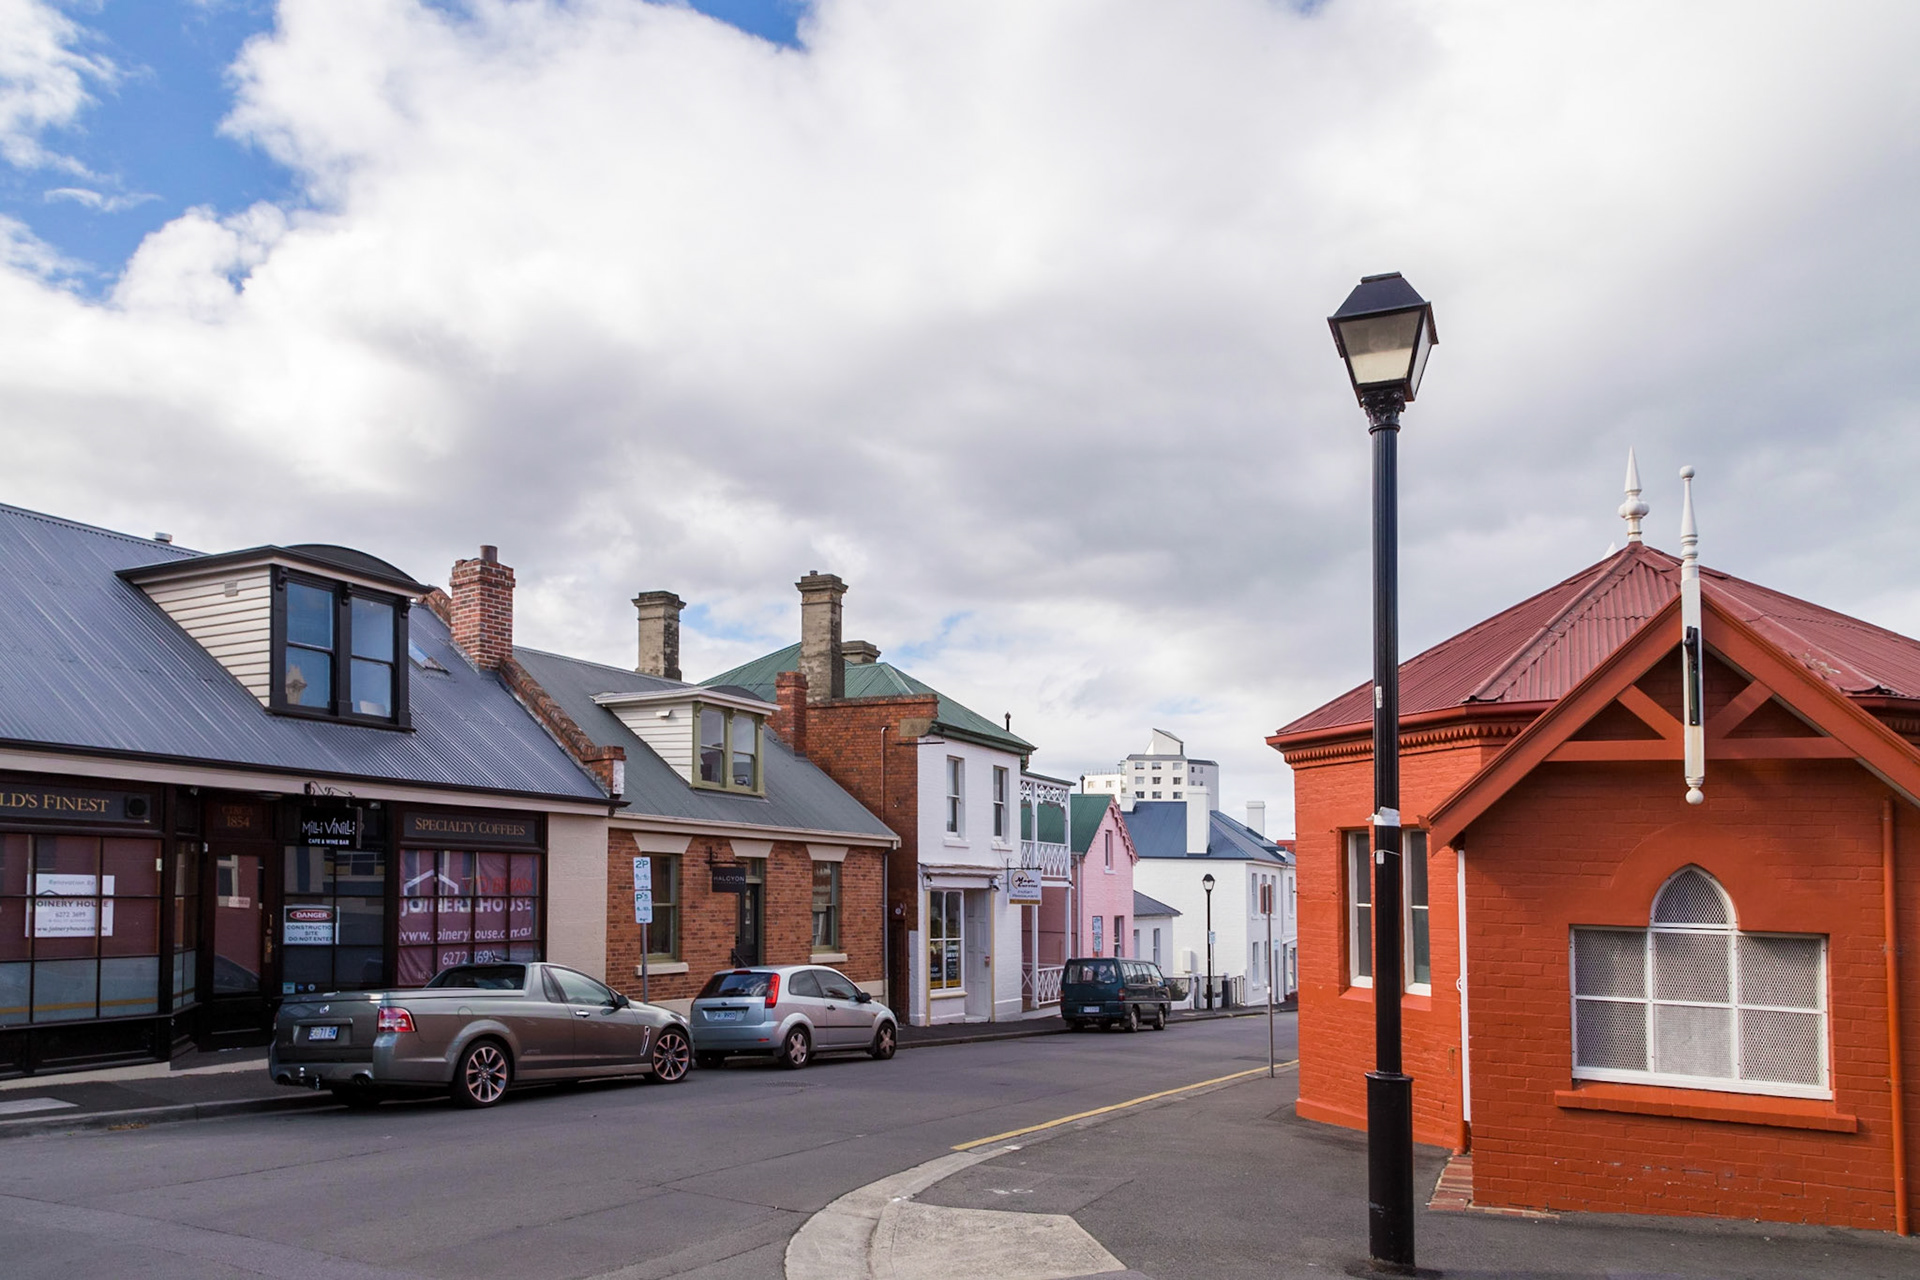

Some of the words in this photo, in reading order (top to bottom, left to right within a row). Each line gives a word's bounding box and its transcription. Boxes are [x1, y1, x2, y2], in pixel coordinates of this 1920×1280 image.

[43, 794, 110, 812] FINEST
[227, 815, 250, 828] 1854
[415, 818, 477, 833] SPECIALTY
[479, 822, 526, 836] COFFEES
[635, 860, 649, 869] 2P
[36, 900, 73, 908] OINERY
[76, 900, 109, 908] HOUE
[479, 897, 532, 912] HOUSE
[442, 950, 468, 966] 6272
